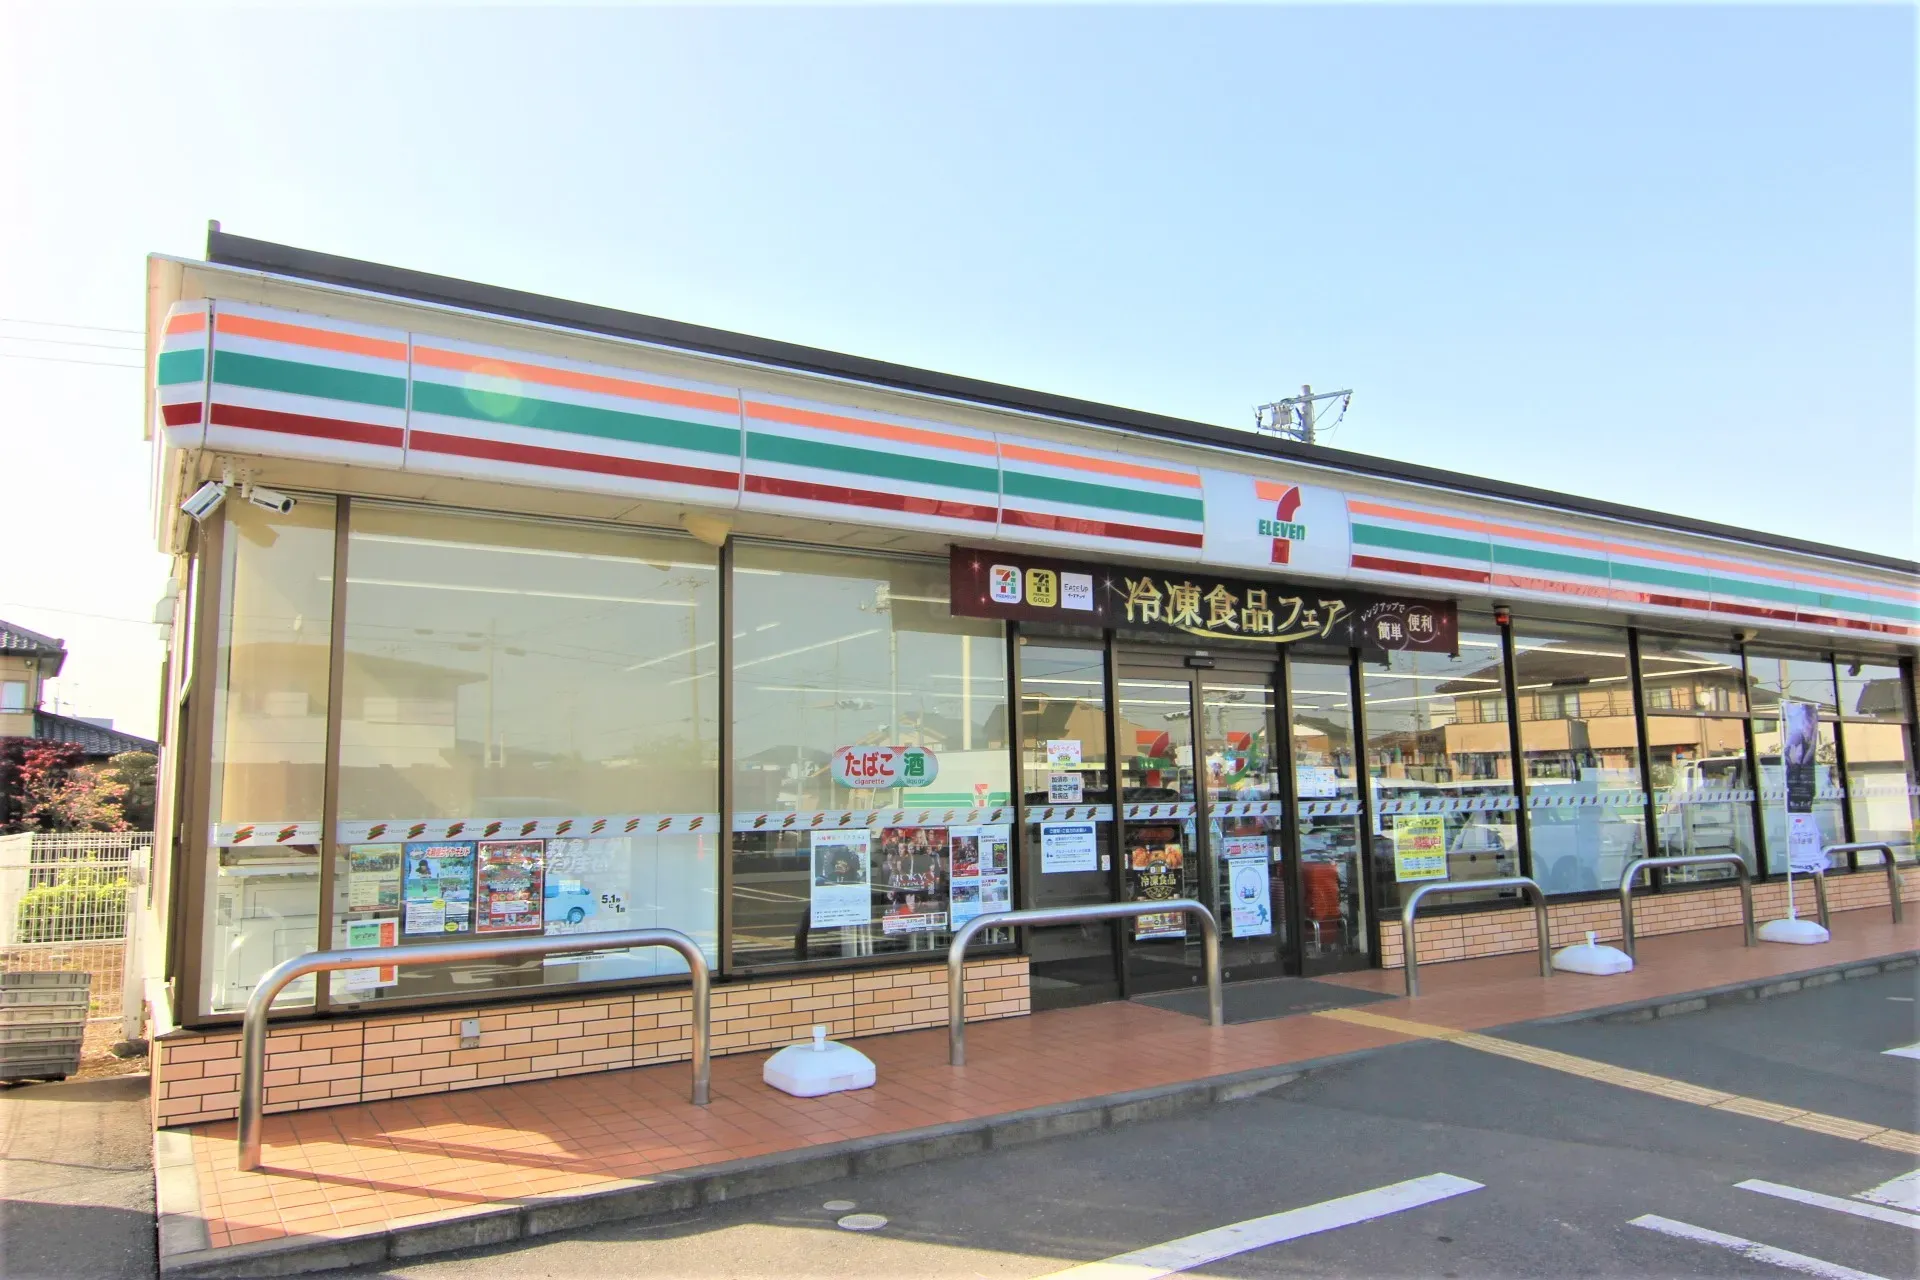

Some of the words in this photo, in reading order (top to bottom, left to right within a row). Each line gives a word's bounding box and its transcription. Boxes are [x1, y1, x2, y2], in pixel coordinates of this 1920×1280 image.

[1124, 576, 1347, 639] 冷凍食品フェア
[1360, 602, 1406, 622] レンジアップで
[1377, 621, 1403, 641] 簡単
[1407, 613, 1433, 633] 便利
[844, 751, 895, 777] たばこ
[903, 752, 925, 777] 酒
[854, 778, 885, 786] cigarette
[1141, 874, 1177, 888] 冷凍食品
